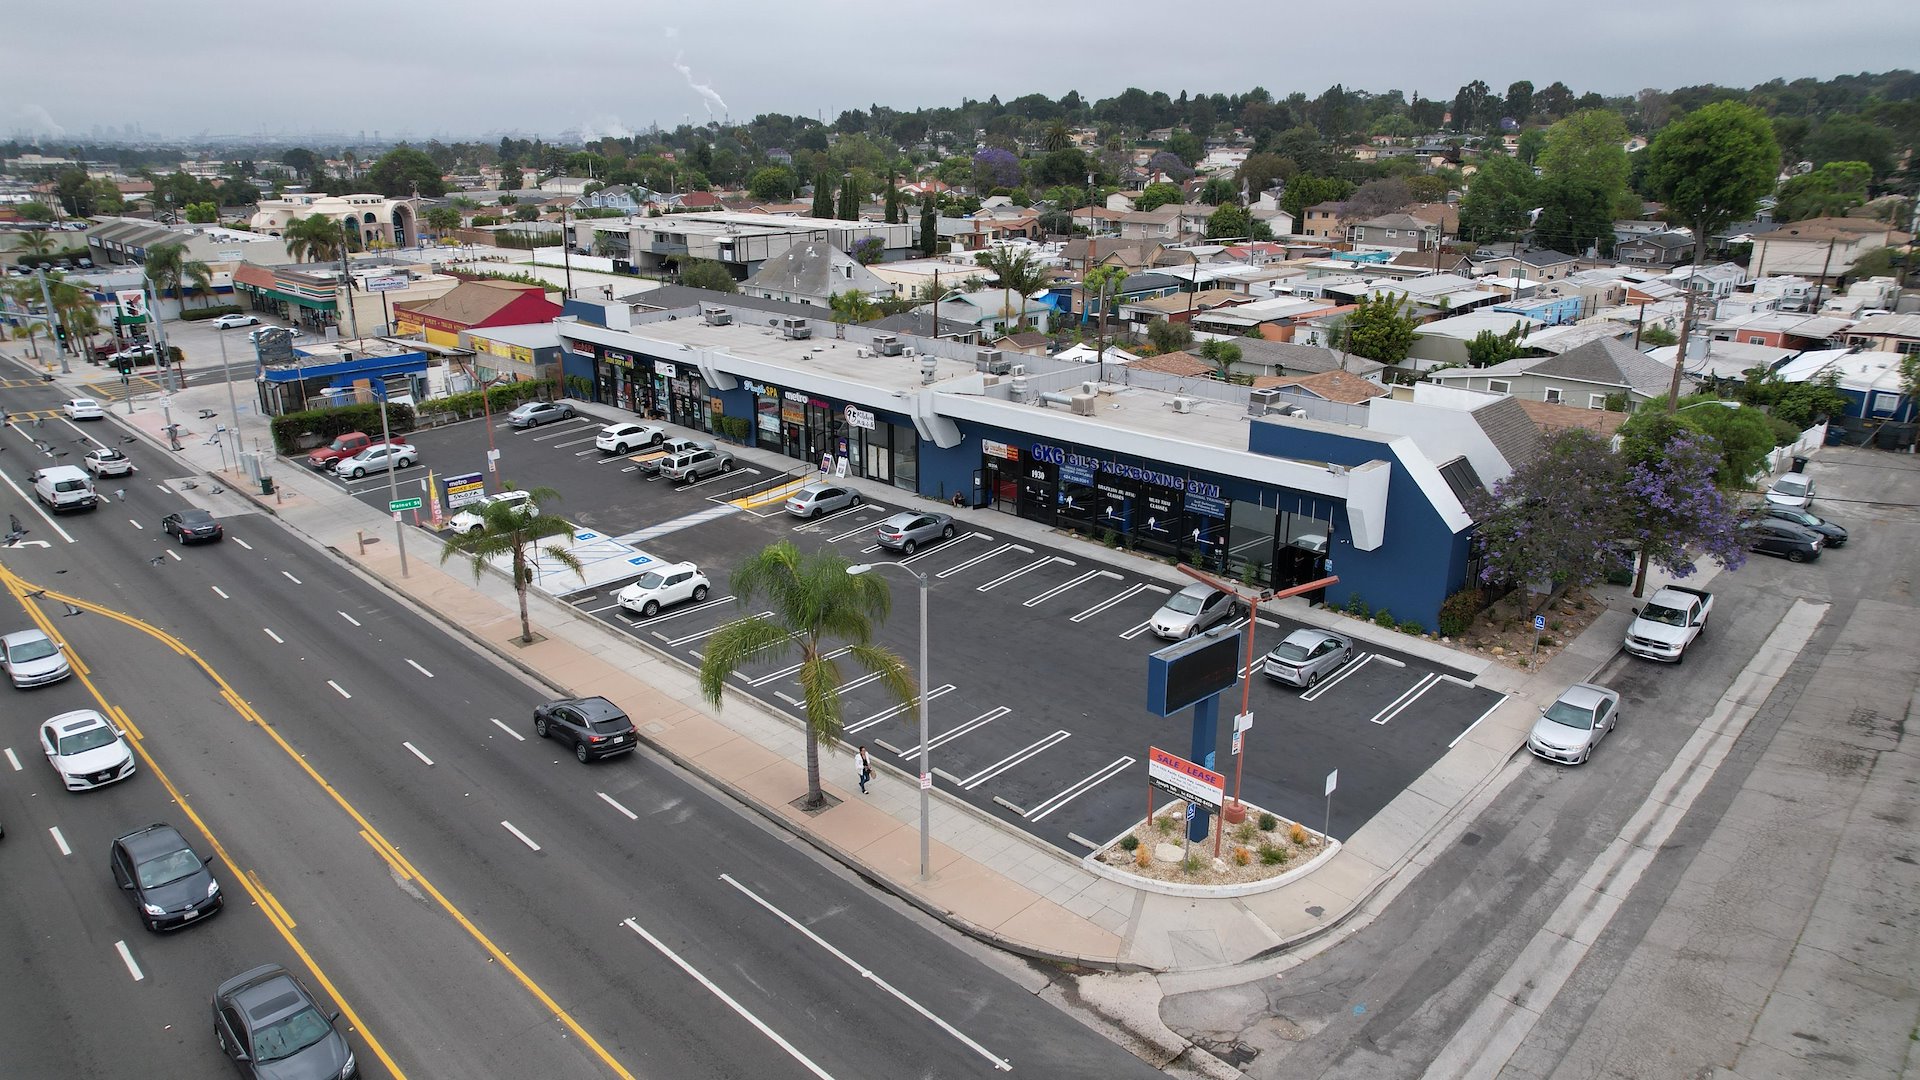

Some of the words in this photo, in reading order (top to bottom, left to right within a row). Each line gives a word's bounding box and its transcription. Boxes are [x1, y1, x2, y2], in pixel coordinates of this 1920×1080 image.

[765, 386, 778, 398] SPA
[784, 391, 809, 404] metro
[1031, 443, 1065, 465] GKG
[1068, 453, 1099, 471] GIL'S
[1102, 461, 1184, 490] KICKBOXING
[1187, 480, 1219, 498] GYM
[1031, 469, 1045, 480] 1930
[449, 479, 468, 487] metro
[1107, 492, 1125, 501] CLASSES
[1149, 503, 1168, 512] CLASSES
[1157, 754, 1179, 768] SALE
[1187, 767, 1216, 784] LEASE
